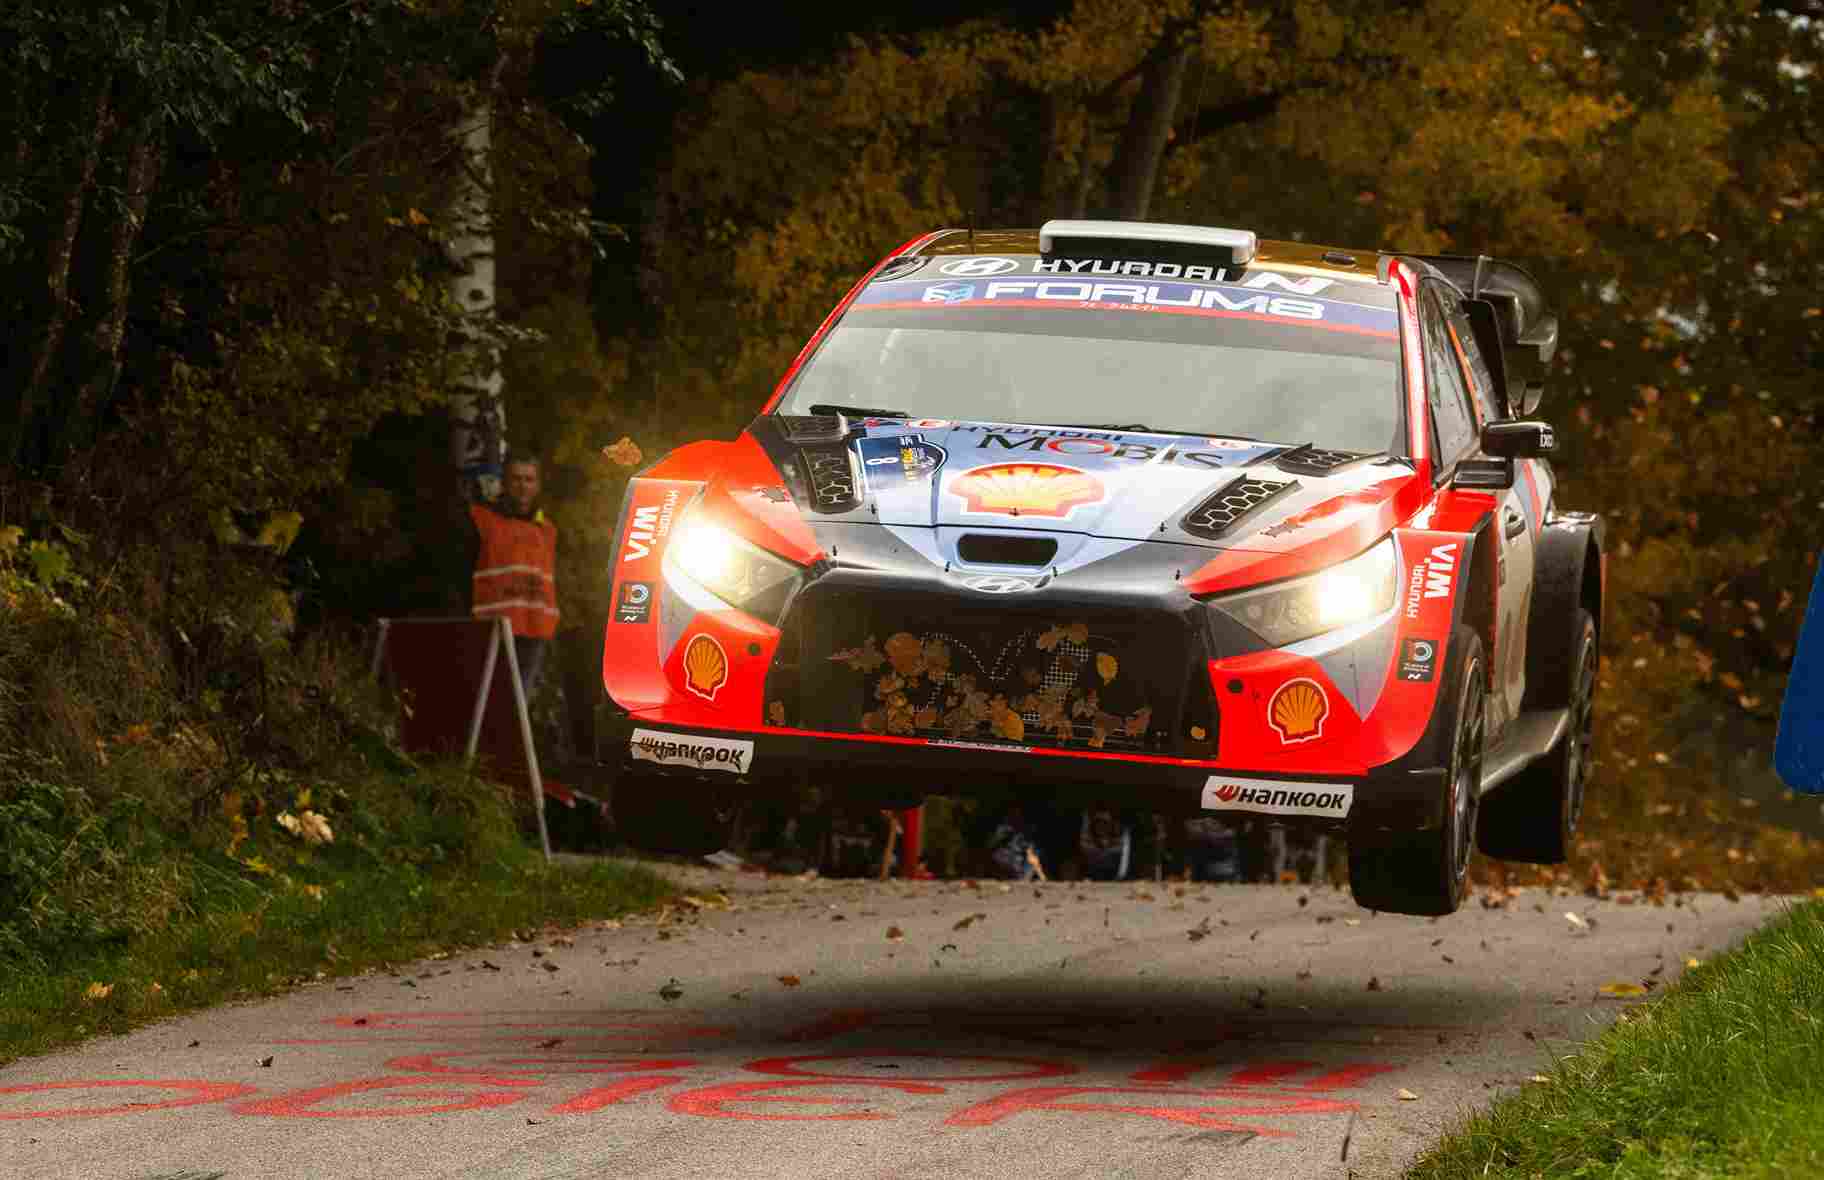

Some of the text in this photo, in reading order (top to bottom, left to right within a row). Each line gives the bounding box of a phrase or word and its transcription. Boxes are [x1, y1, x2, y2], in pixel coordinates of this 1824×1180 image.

[1032, 259, 1229, 282] HYUNDAI
[984, 281, 1326, 320] FORUM8
[951, 425, 1123, 441] HYUNDAI
[978, 433, 1224, 470] MOBIS
[657, 489, 681, 537] HYUNDAI
[1407, 564, 1425, 618] HYUNDAI
